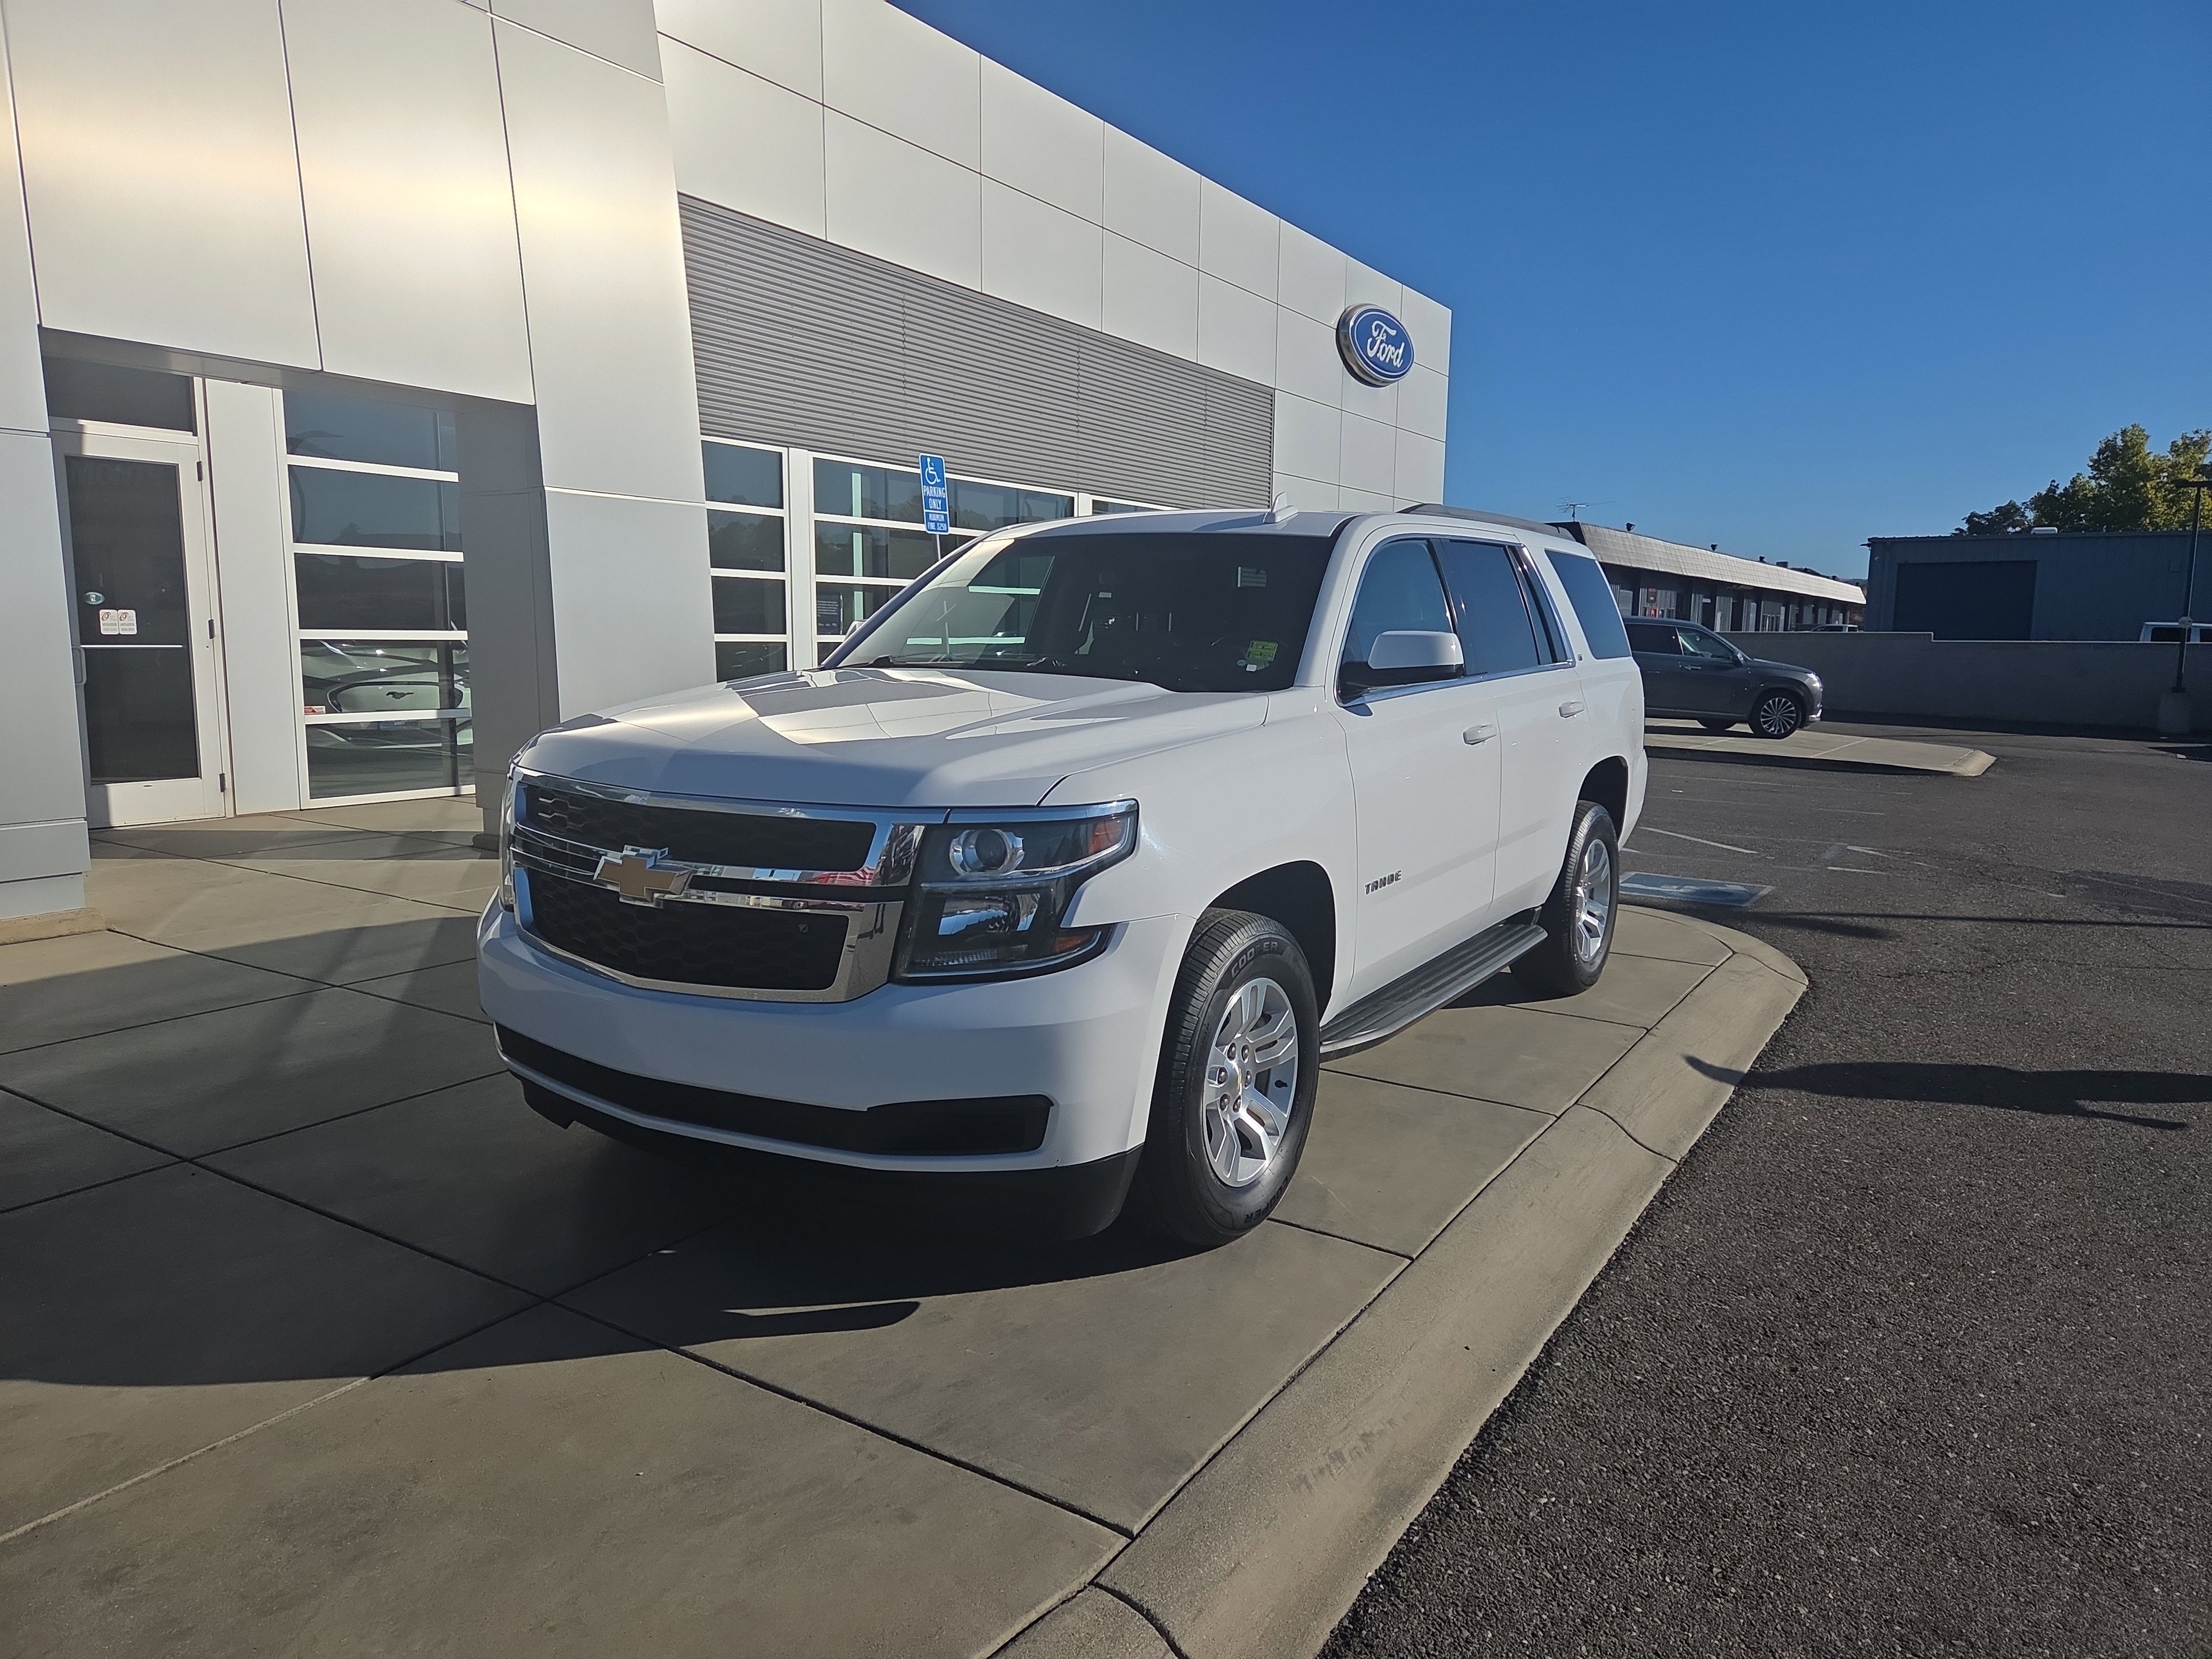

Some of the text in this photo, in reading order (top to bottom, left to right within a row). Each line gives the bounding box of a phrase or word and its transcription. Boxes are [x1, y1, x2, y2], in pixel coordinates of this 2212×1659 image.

[1367, 320, 1405, 368] Ford
[923, 485, 946, 498] PARKING
[929, 499, 942, 510] ONLY
[1365, 870, 1402, 895] TAHOE
[1244, 1175, 1289, 1223] COOPER
